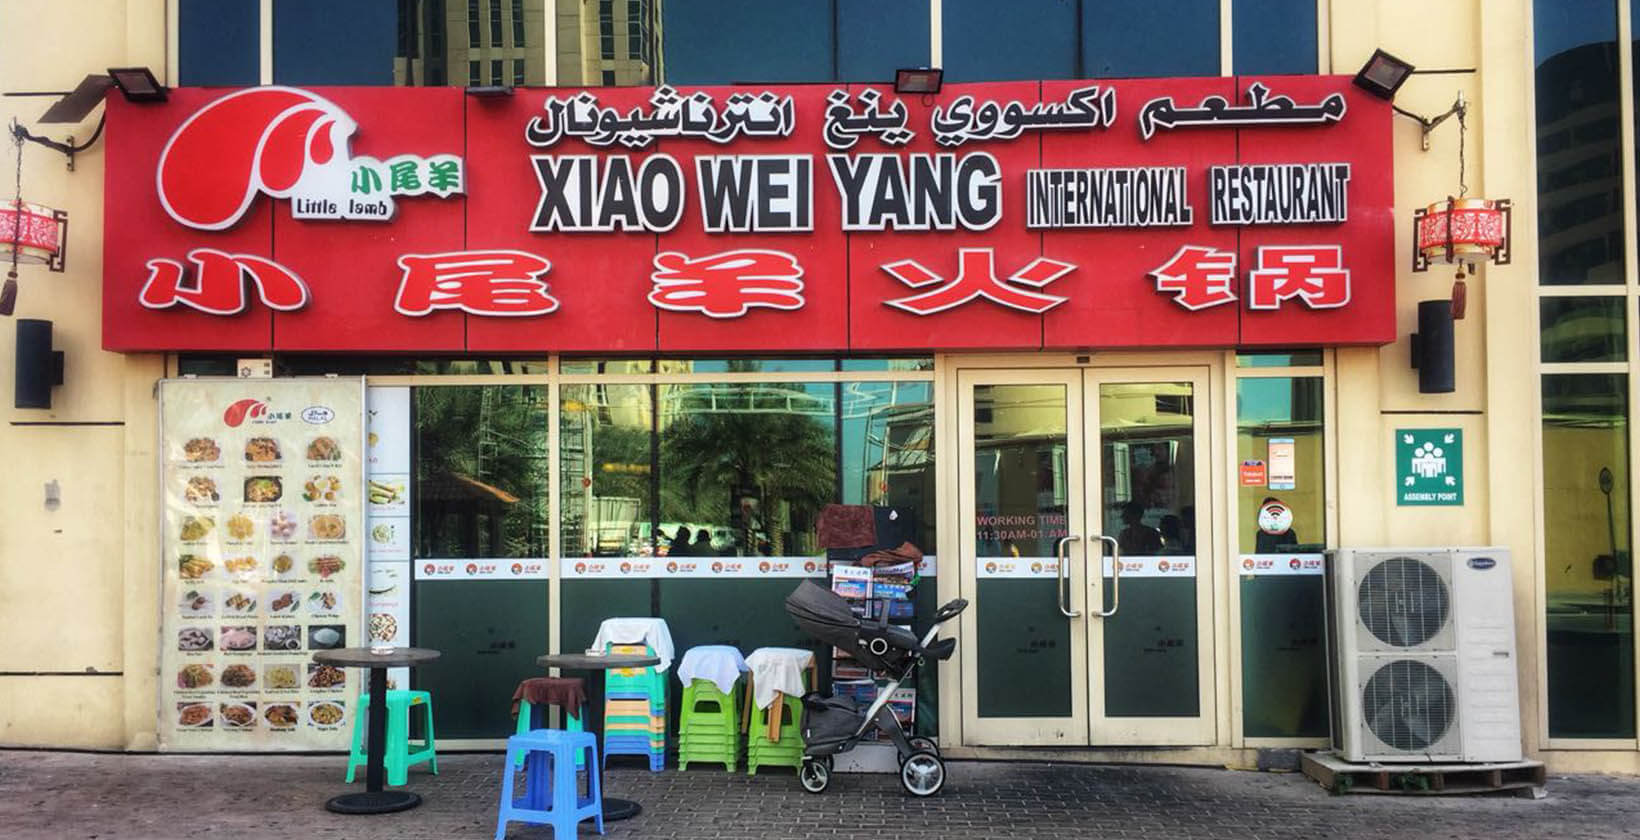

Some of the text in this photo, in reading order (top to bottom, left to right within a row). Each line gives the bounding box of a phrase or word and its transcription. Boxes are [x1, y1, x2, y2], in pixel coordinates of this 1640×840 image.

[823, 89, 915, 148] ينغ
[1140, 83, 1344, 139] مطعم
[351, 160, 459, 194] 小尾羊
[530, 152, 1351, 232] XIAO WEI YANG INTERNATIONAL RESTAURANT
[296, 198, 388, 216] Little lamb
[1403, 492, 1457, 502] ASSEMBLY POINT
[976, 514, 1067, 526] WORKING TIME
